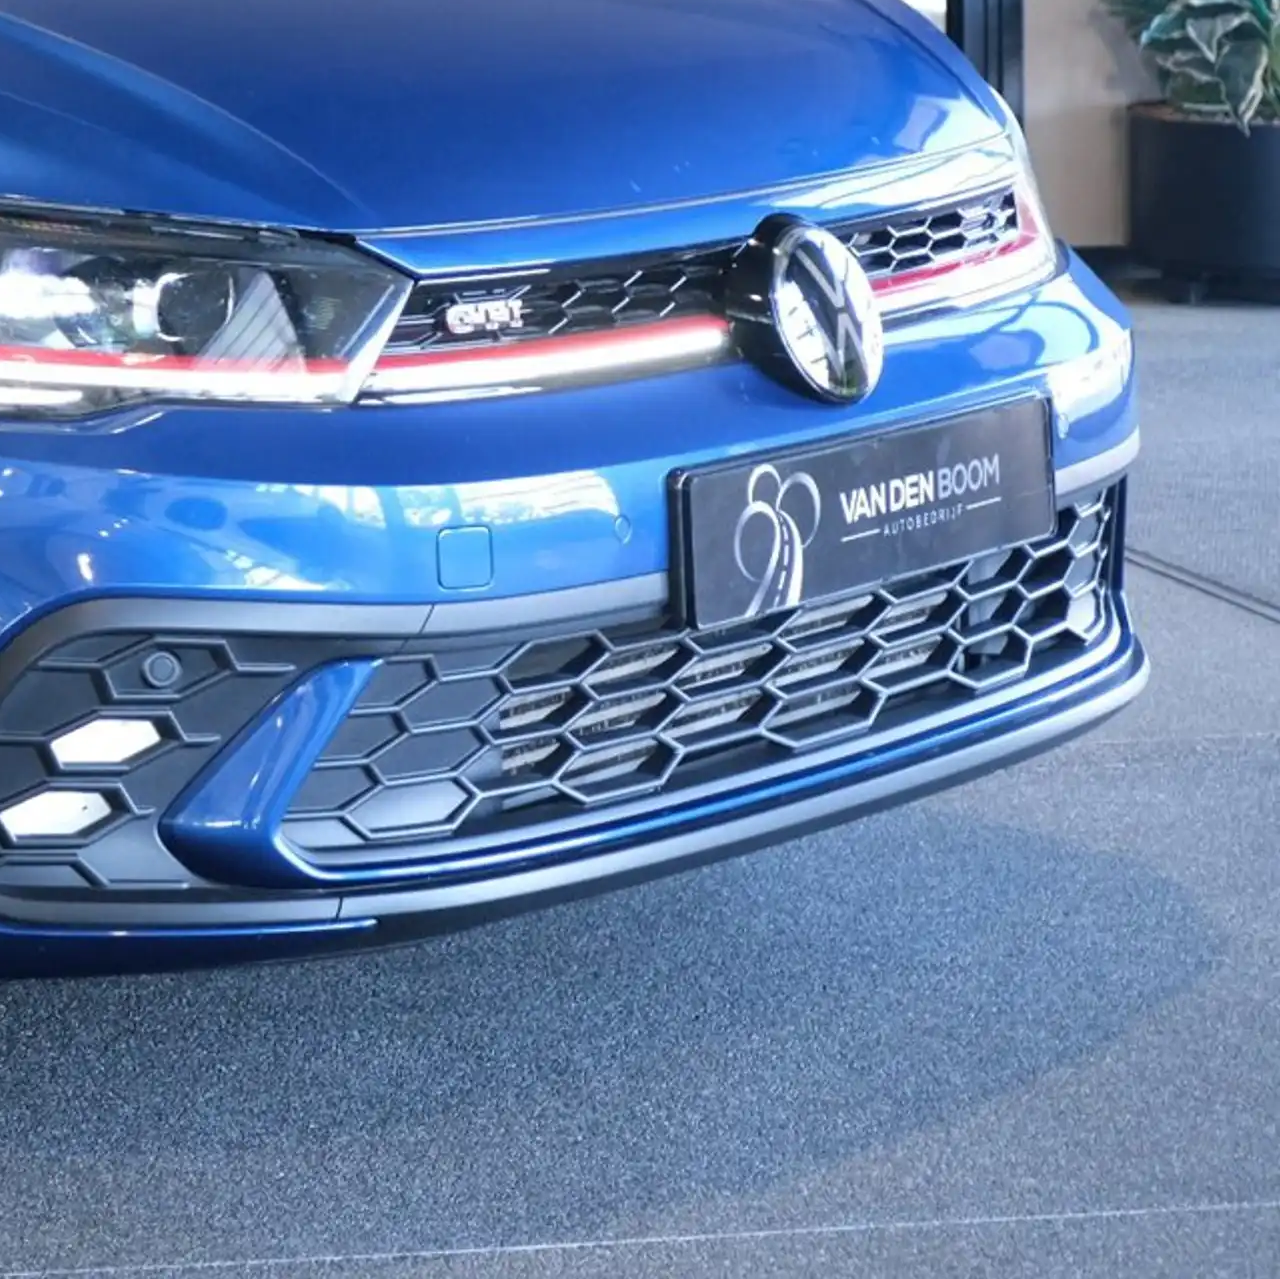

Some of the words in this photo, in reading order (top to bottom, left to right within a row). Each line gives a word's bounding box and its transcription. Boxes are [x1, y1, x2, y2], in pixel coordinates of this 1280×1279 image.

[840, 481, 886, 525] VAN
[889, 470, 934, 513] DEN
[937, 452, 1000, 501] BOOM
[883, 502, 964, 537] AUTOBEDRIJF
